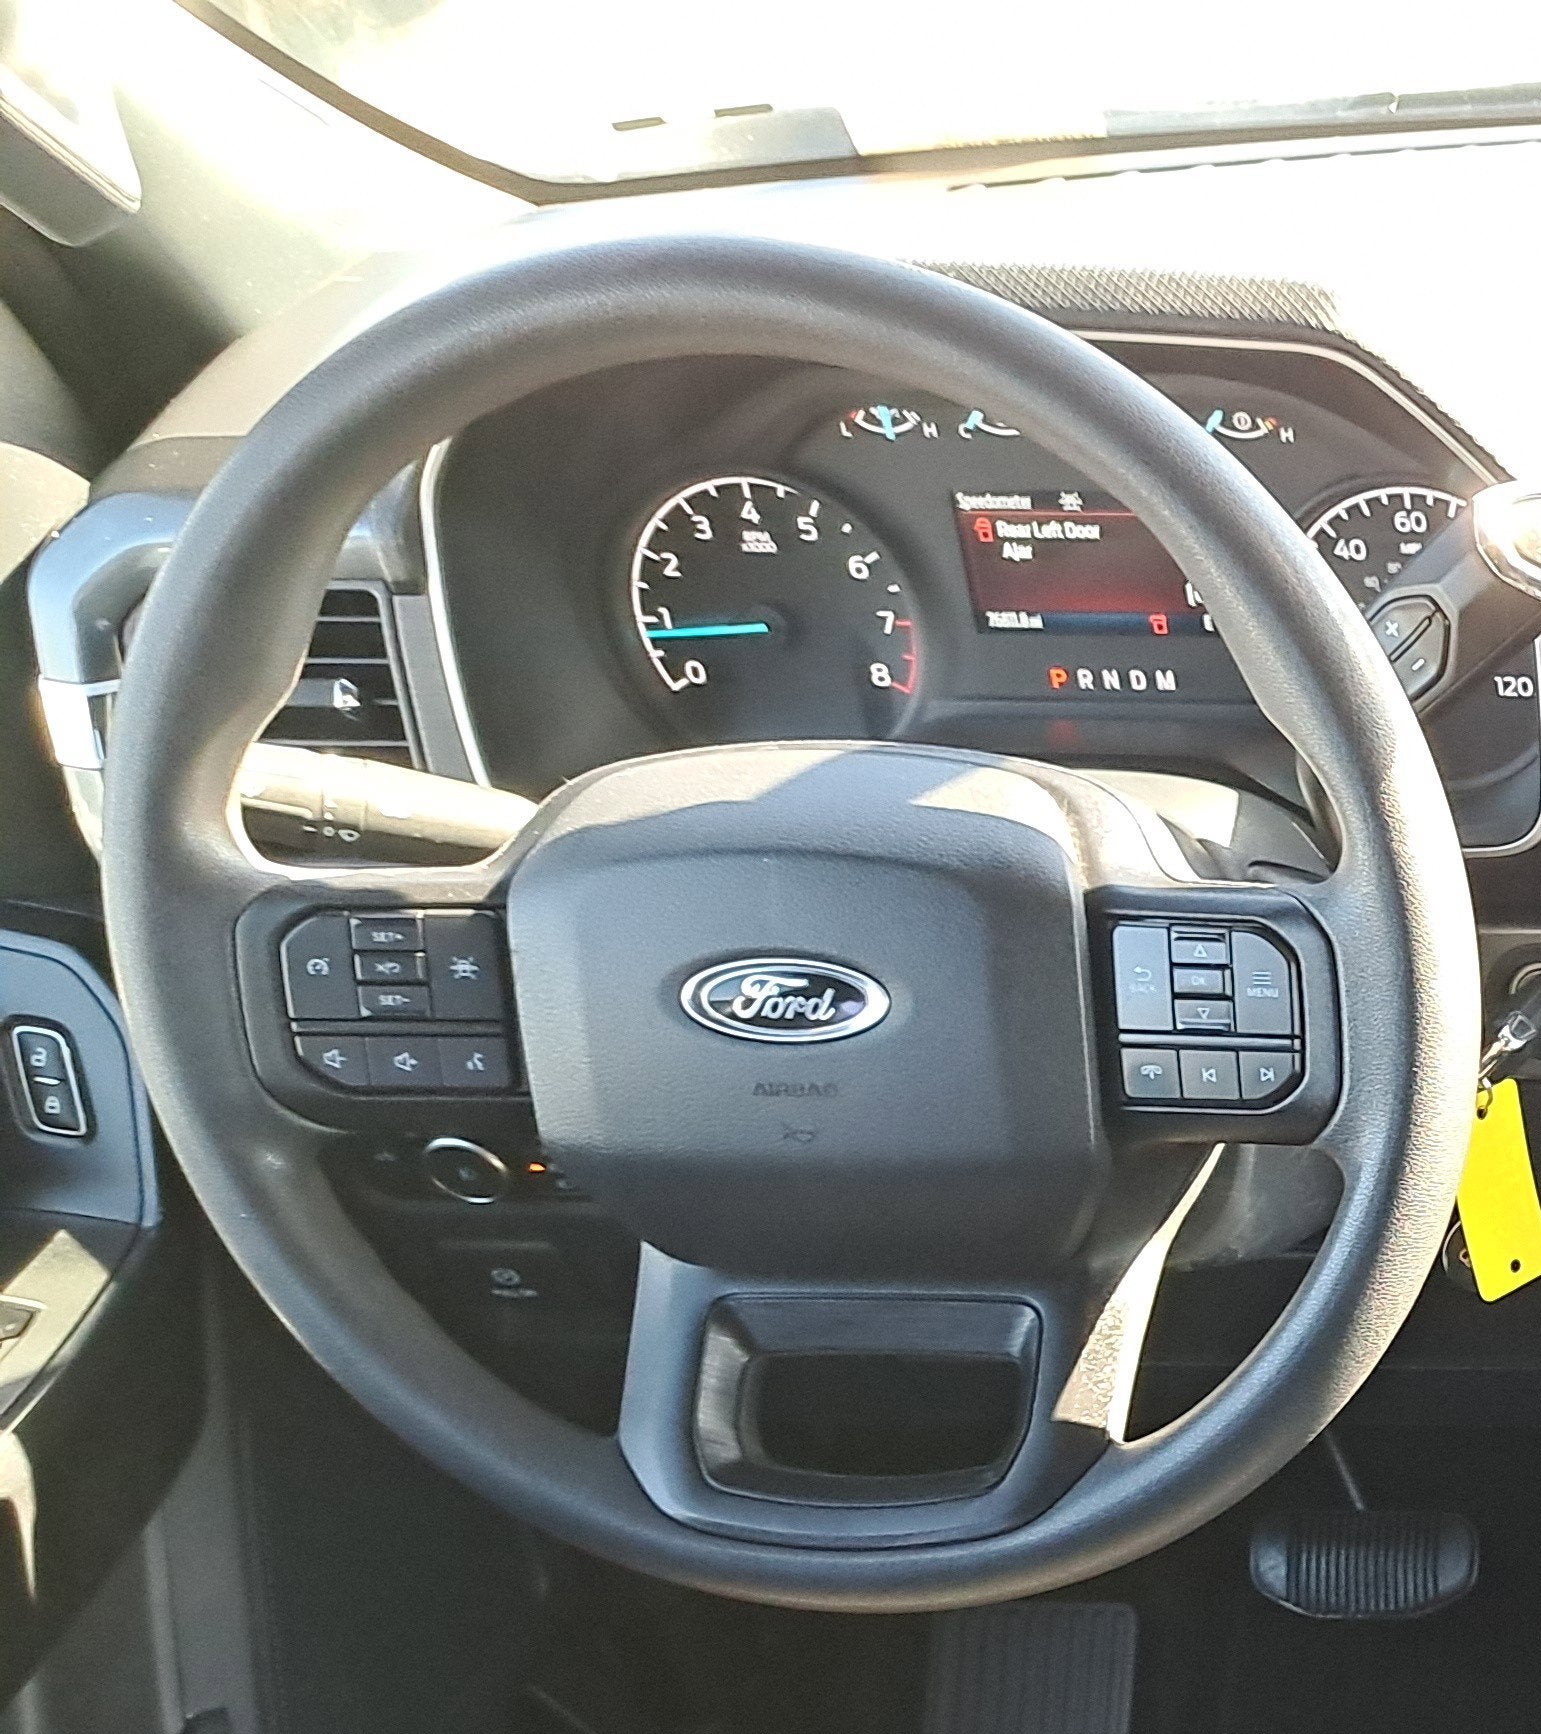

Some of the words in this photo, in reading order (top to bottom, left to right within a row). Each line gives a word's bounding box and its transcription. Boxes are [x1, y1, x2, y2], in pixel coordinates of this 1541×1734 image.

[921, 420, 939, 440] H
[1279, 426, 1295, 444] H
[739, 500, 761, 525] 4
[1394, 509, 1429, 533] 60
[690, 514, 714, 541] 3
[796, 515, 819, 542] 5
[994, 519, 1032, 539] Rear
[1031, 521, 1065, 540] Left
[1063, 522, 1102, 541] Door
[1001, 541, 1034, 562] Ajar
[1333, 537, 1368, 561] 40
[659, 552, 684, 578] 2
[848, 554, 870, 580] 6
[657, 605, 674, 630] 1
[875, 609, 895, 635] 7
[683, 659, 707, 686] 0
[869, 661, 892, 688] 8
[1049, 666, 1069, 690] P
[1076, 667, 1095, 691] R
[1101, 668, 1122, 692] N
[1127, 668, 1147, 692] D
[1154, 669, 1178, 692] M
[1493, 675, 1534, 698] 120
[732, 974, 836, 1021] Ford
[1246, 987, 1279, 998] MENU
